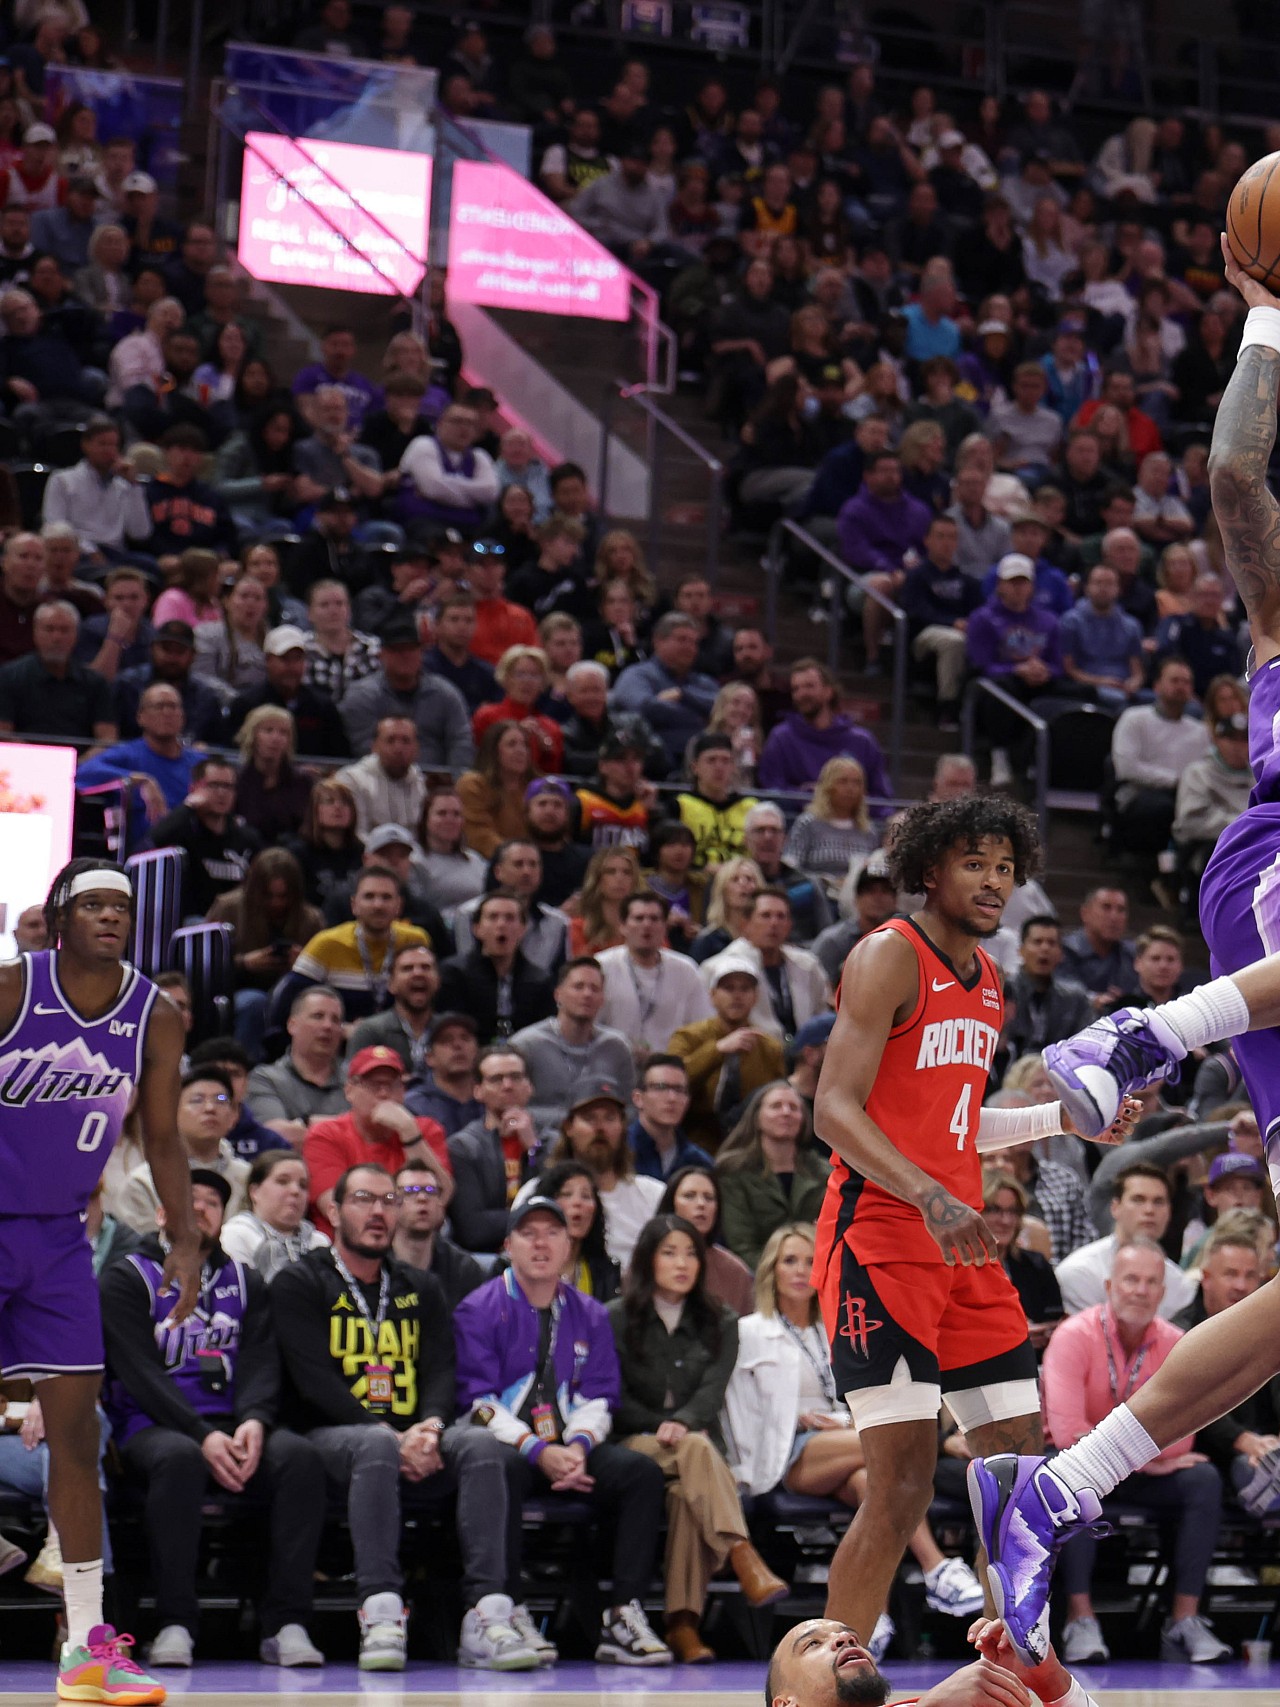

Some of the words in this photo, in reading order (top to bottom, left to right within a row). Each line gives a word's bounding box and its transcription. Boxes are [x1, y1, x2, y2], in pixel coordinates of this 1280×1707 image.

[0, 1056, 131, 1108] UTAH
[76, 1111, 109, 1152] 0
[949, 1083, 972, 1151] 4
[330, 1315, 420, 1361] UTAH
